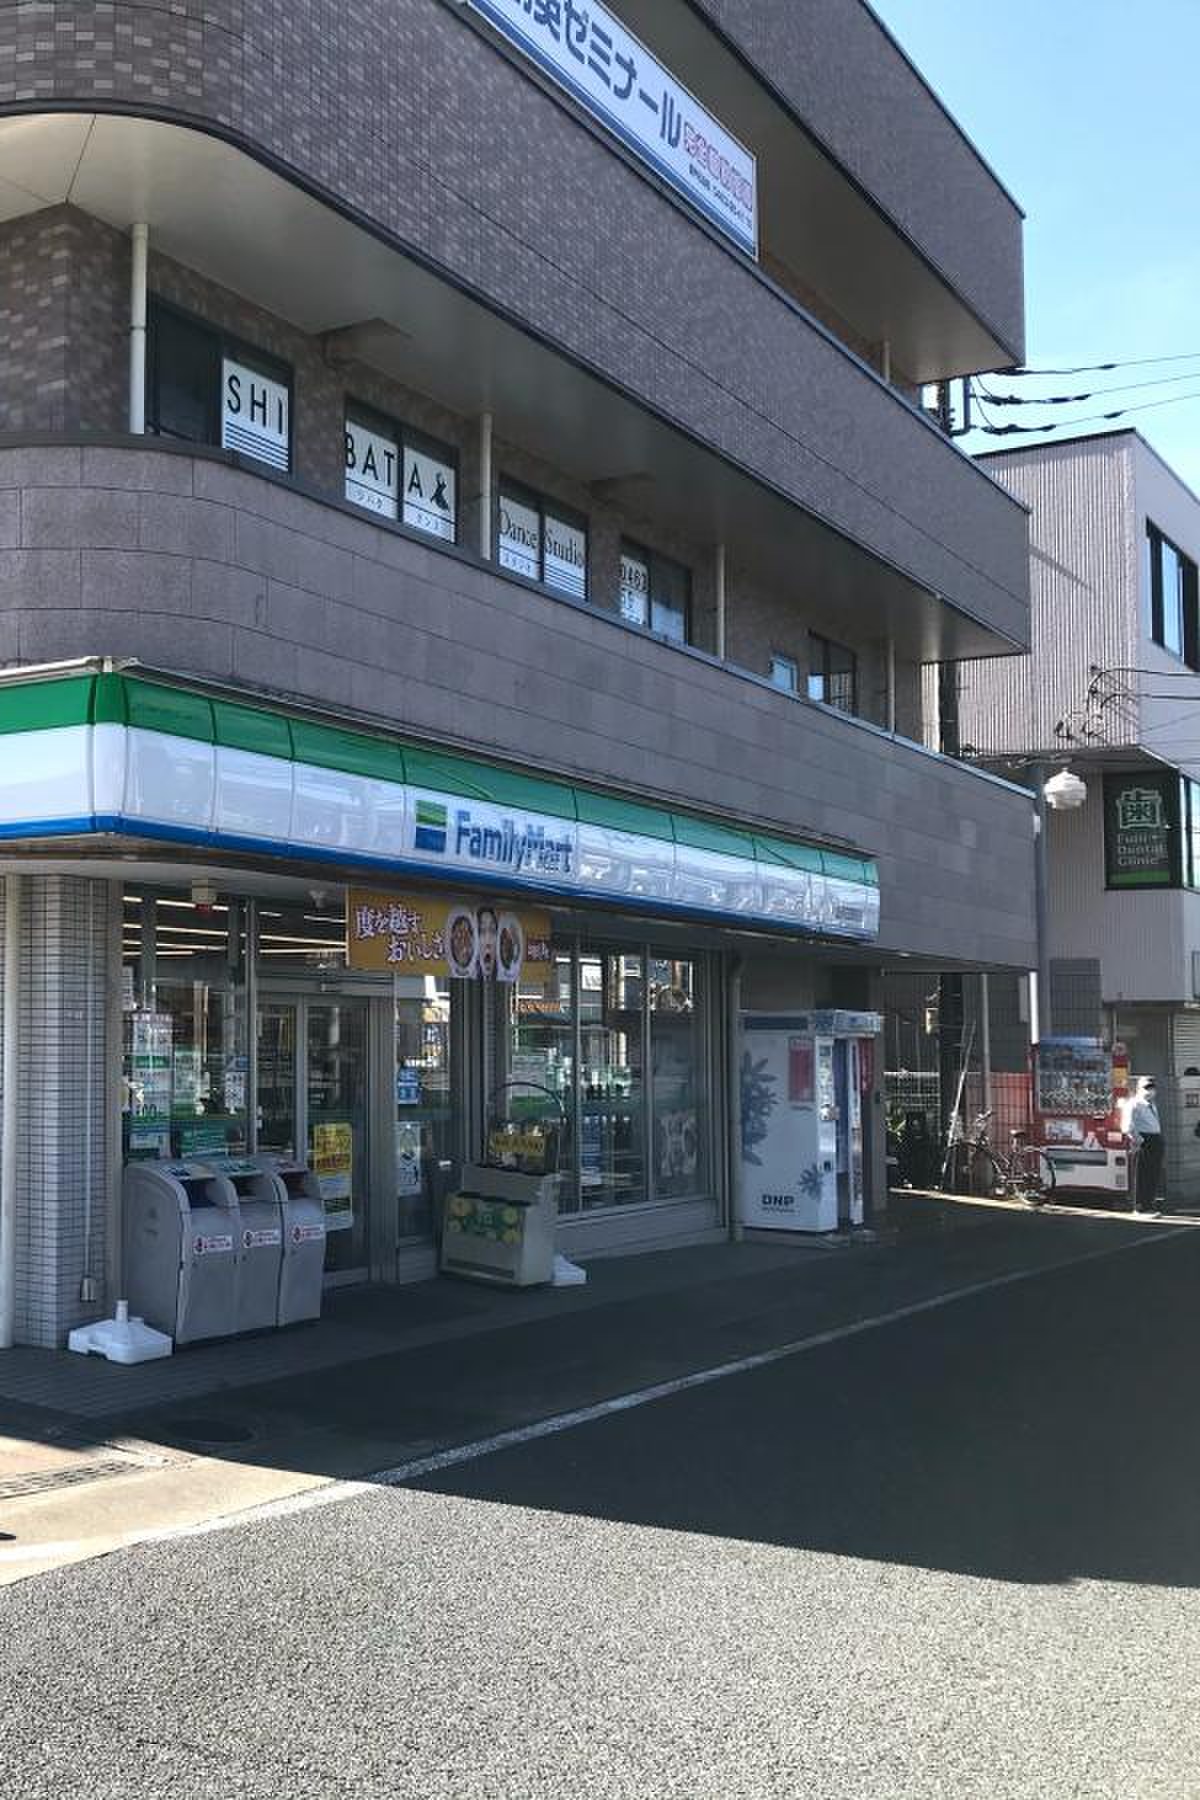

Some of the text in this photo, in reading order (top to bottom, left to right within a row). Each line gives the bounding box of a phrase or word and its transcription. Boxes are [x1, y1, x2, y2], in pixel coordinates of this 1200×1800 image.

[513, 0, 682, 148] 英ゼミナール
[226, 374, 284, 434] SHI
[456, 810, 573, 874] FamilyMart
